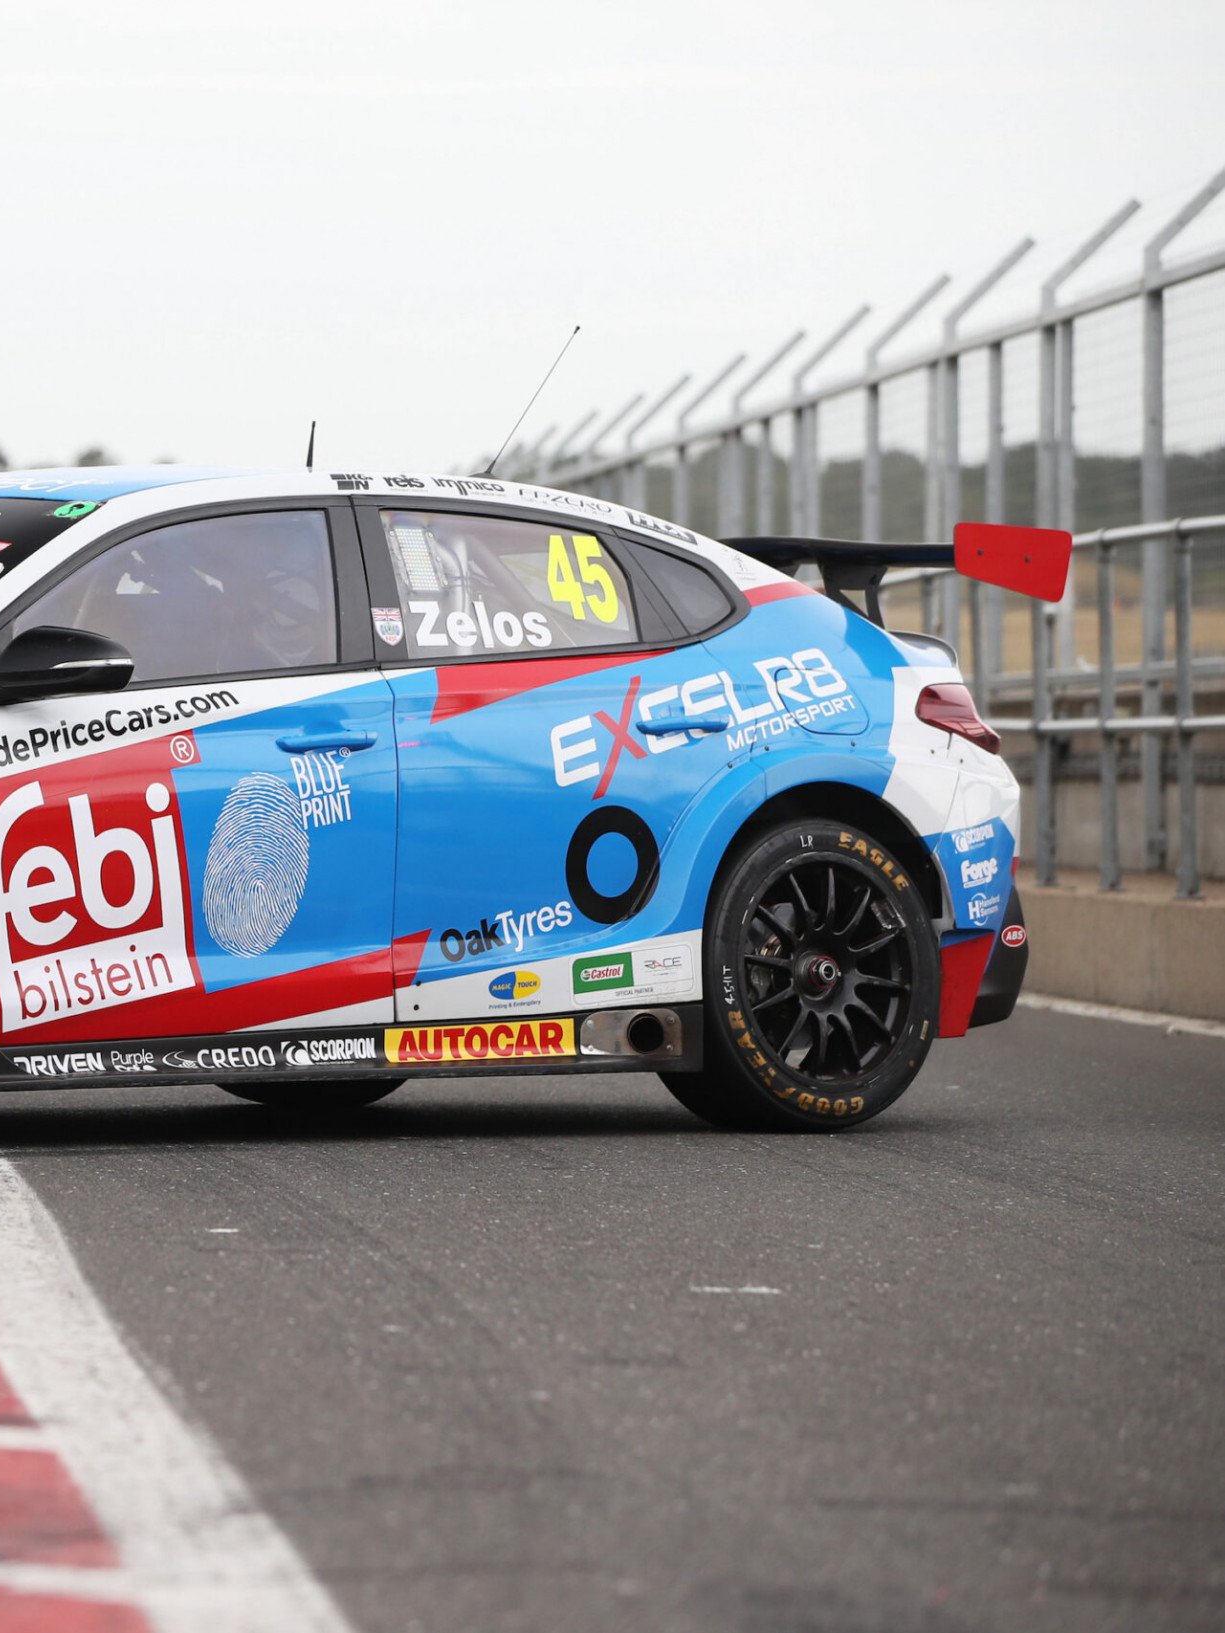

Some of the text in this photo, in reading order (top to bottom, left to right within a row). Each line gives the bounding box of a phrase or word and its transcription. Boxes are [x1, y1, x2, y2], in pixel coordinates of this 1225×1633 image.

[547, 534, 619, 624] 45
[407, 600, 553, 649] Zelos
[550, 647, 848, 800] EXCELR8
[726, 695, 857, 752] MOTORSPORT
[290, 750, 350, 800] BLUE
[300, 790, 352, 830] PRINT
[838, 831, 911, 892] EAGLE
[439, 900, 573, 963] OakTyres
[1005, 930, 1024, 941] ABS
[14, 944, 174, 1020] bilstein
[590, 966, 622, 980] Castrol
[13, 1052, 107, 1076] DRIVEN
[110, 1049, 155, 1066] Purple
[196, 1045, 276, 1069] CREDO
[309, 1037, 377, 1062] SCORPION
[397, 1022, 566, 1062] AUTOCAR
